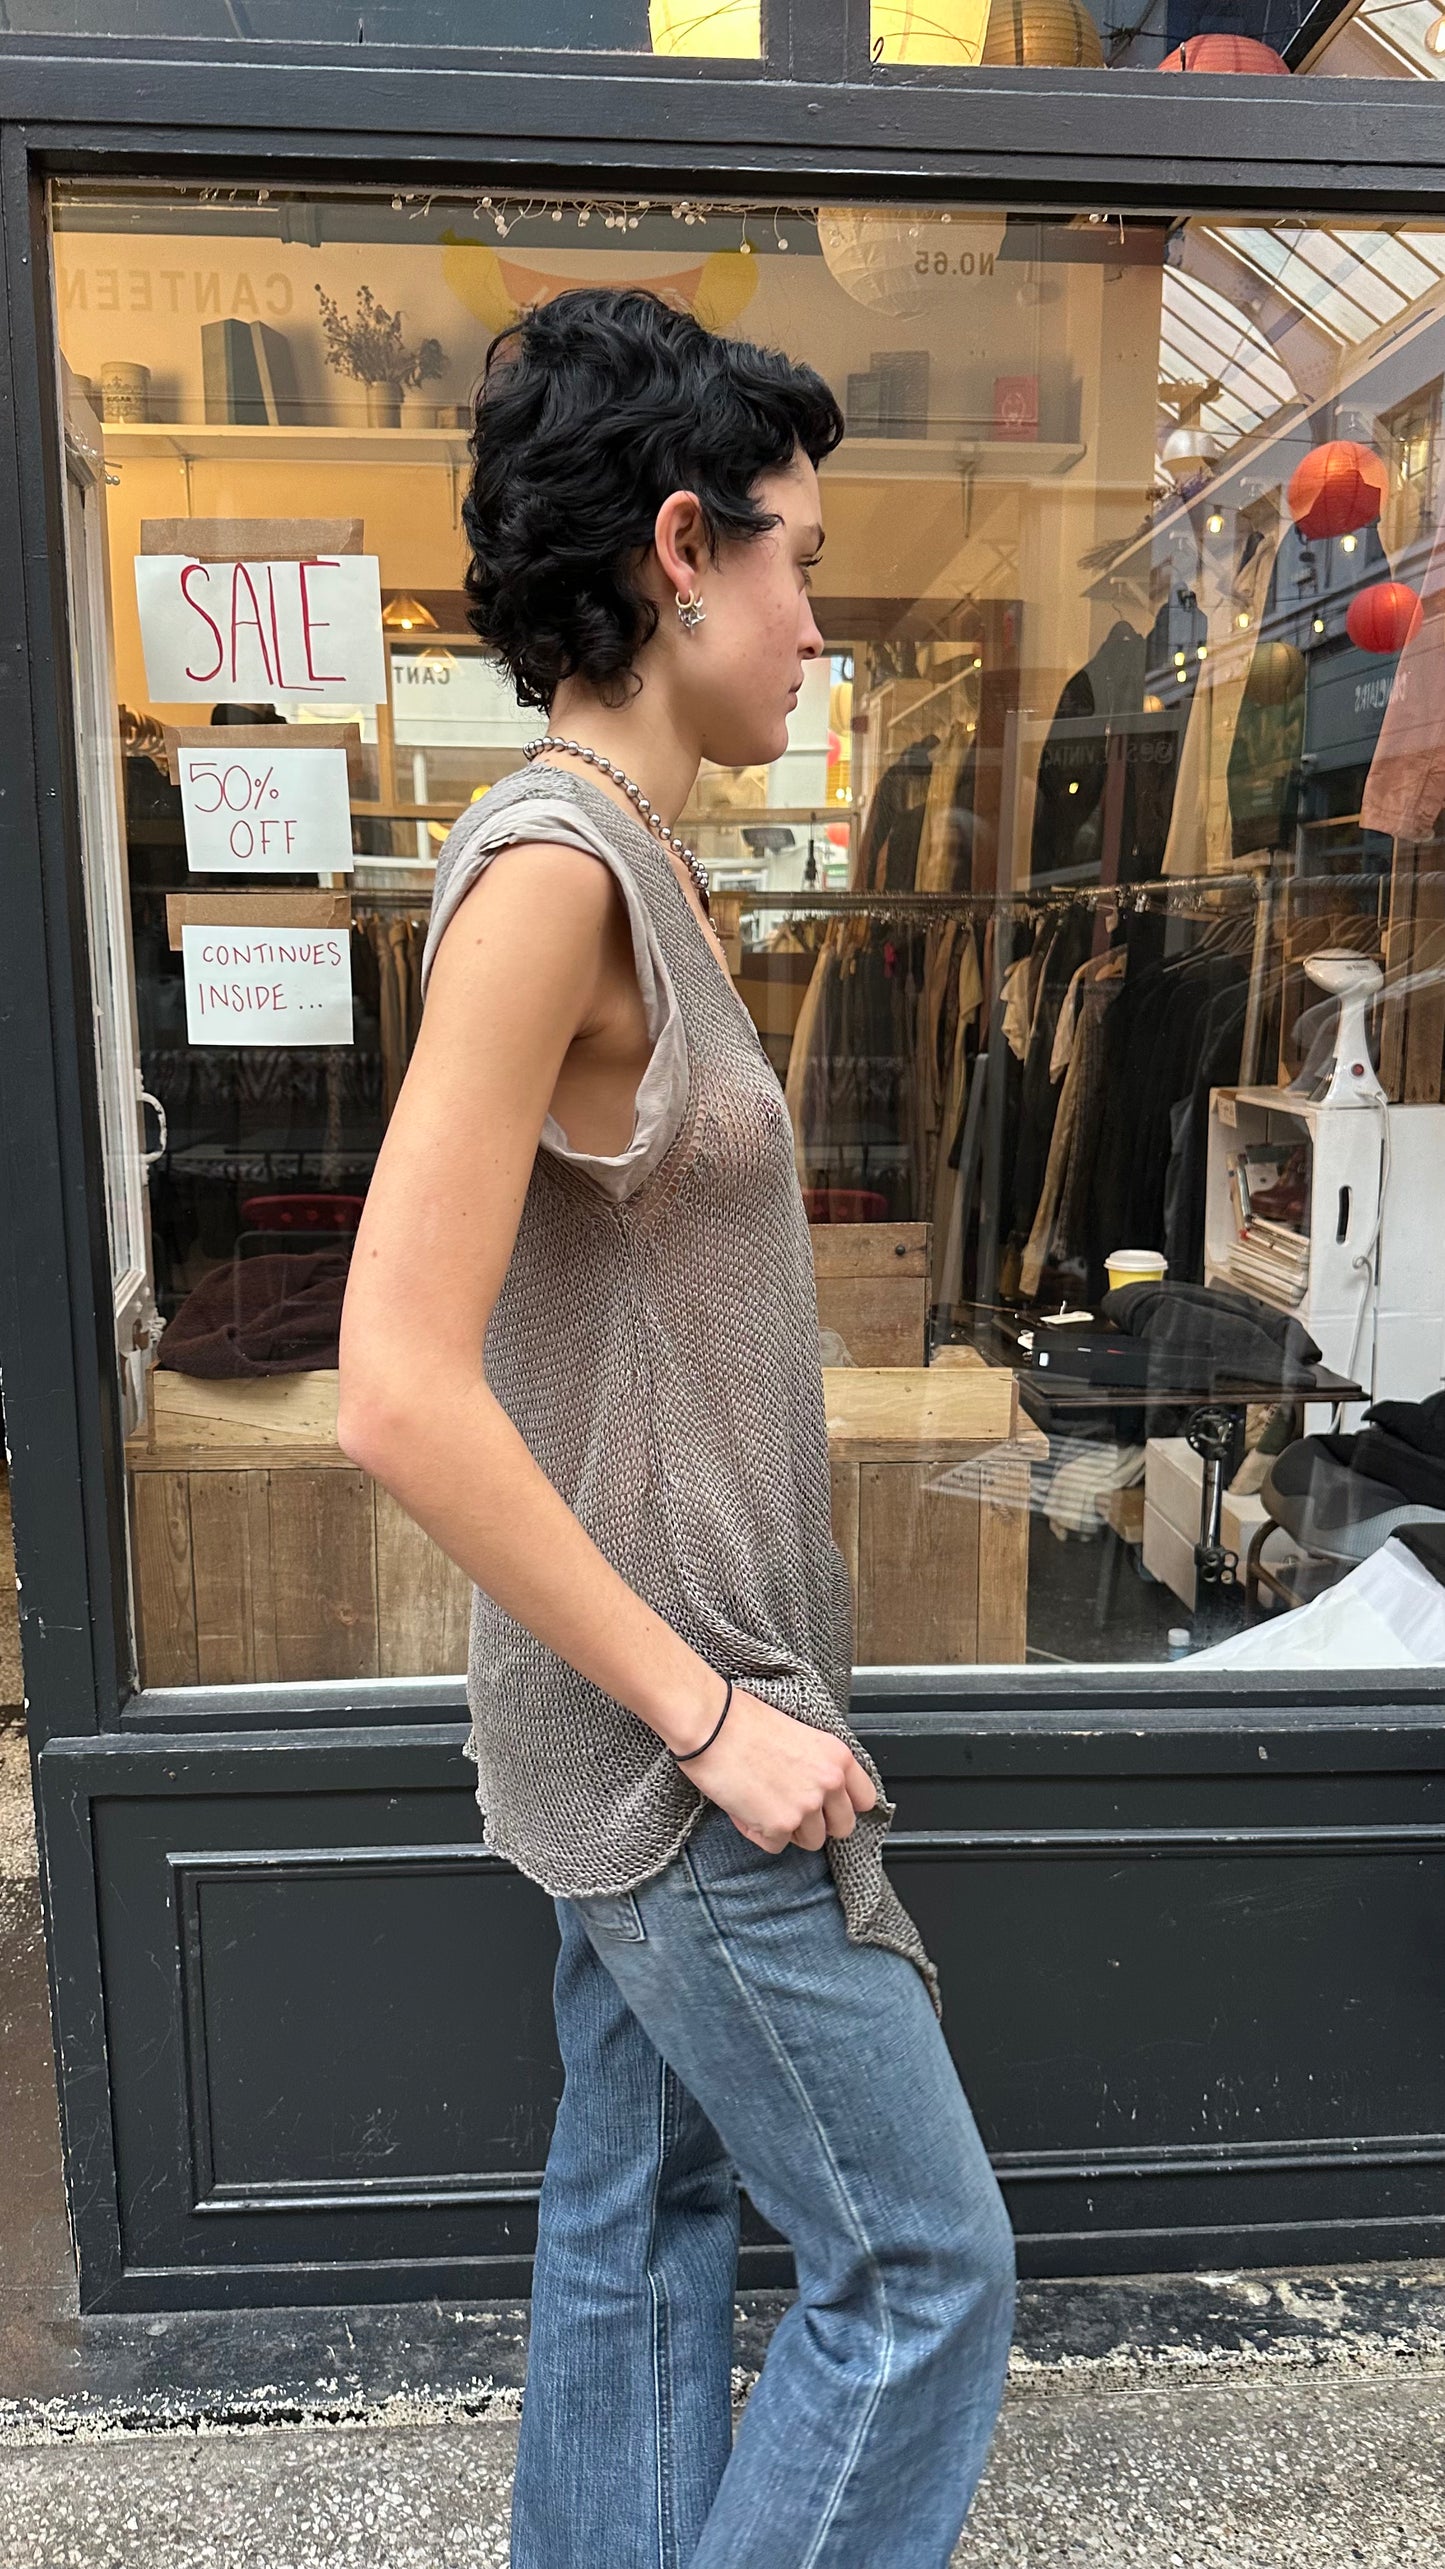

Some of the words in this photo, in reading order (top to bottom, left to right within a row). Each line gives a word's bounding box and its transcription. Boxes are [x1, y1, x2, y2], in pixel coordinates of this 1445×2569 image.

[180, 561, 346, 692] SALE
[189, 762, 279, 813] 50%
[229, 819, 298, 859] OFF
[202, 941, 342, 967] CONTINUES
